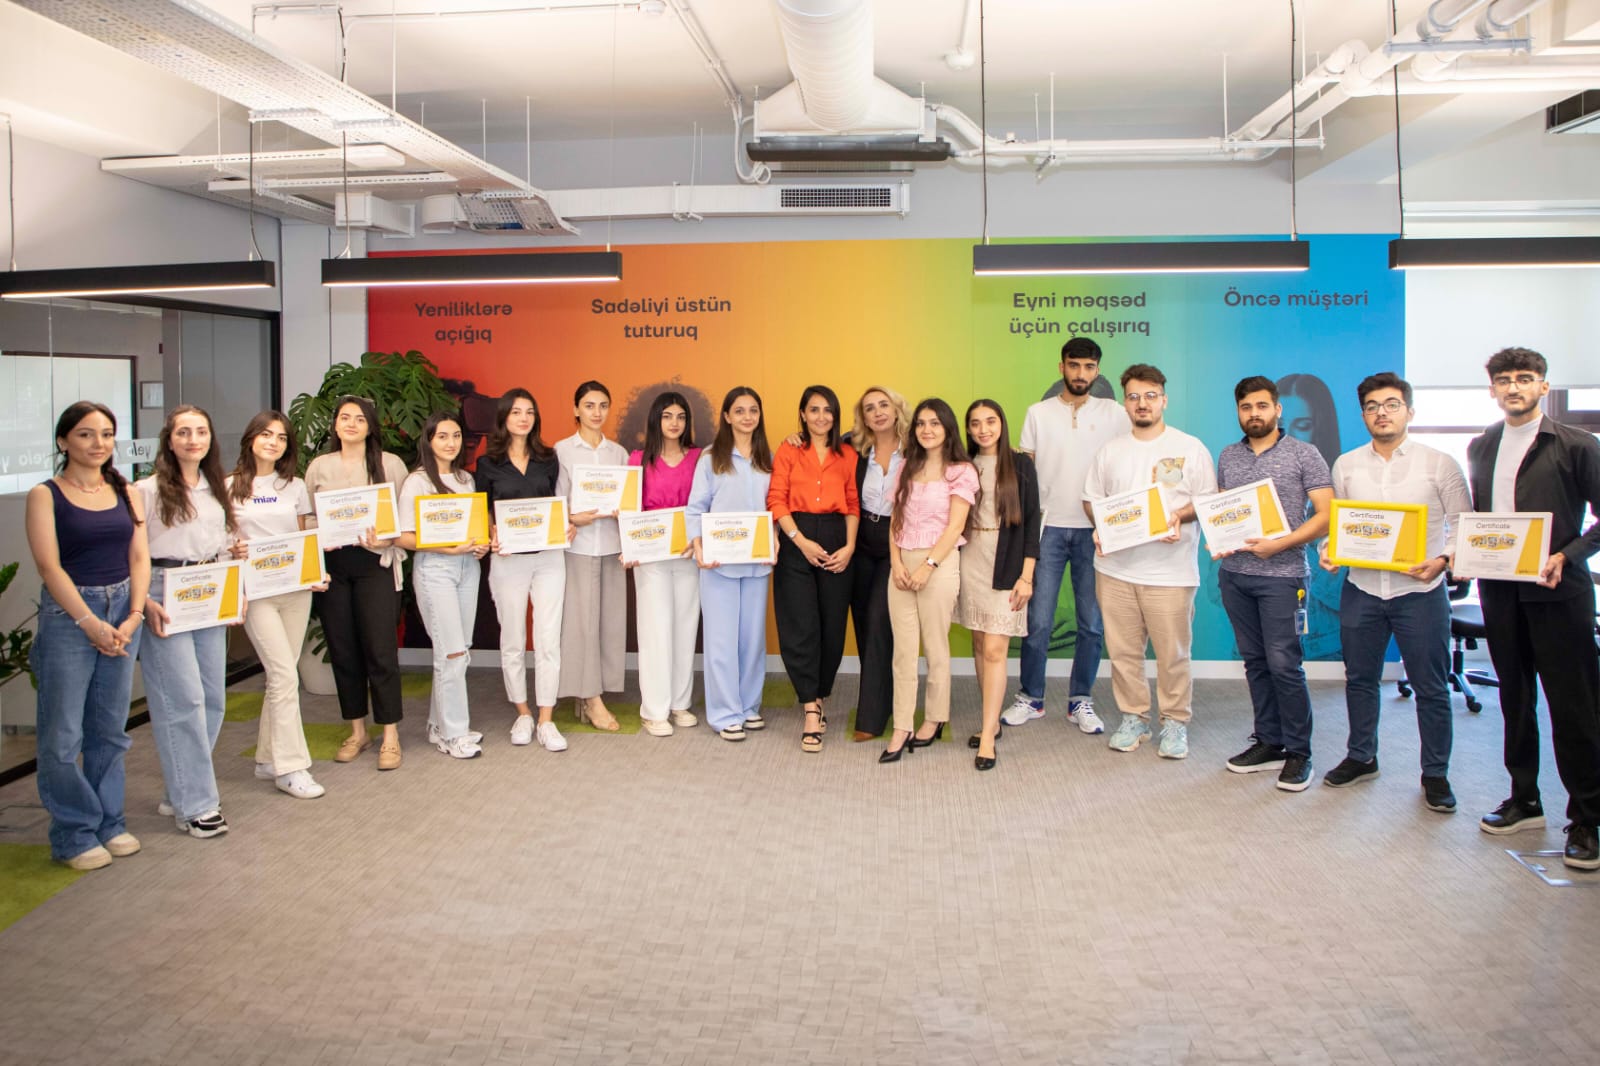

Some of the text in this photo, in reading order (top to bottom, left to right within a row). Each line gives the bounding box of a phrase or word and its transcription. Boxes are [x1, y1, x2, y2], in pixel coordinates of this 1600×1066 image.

[591, 296, 732, 316] Sadəliyi üstün
[1013, 291, 1147, 312] Eyni məqsəd
[1224, 286, 1369, 311] Öncə müştəri
[415, 301, 513, 317] Yeniliklərə
[435, 325, 492, 345] açığıq
[624, 324, 698, 341] tuturuq
[1009, 317, 1150, 339] üçün çalışırıq
